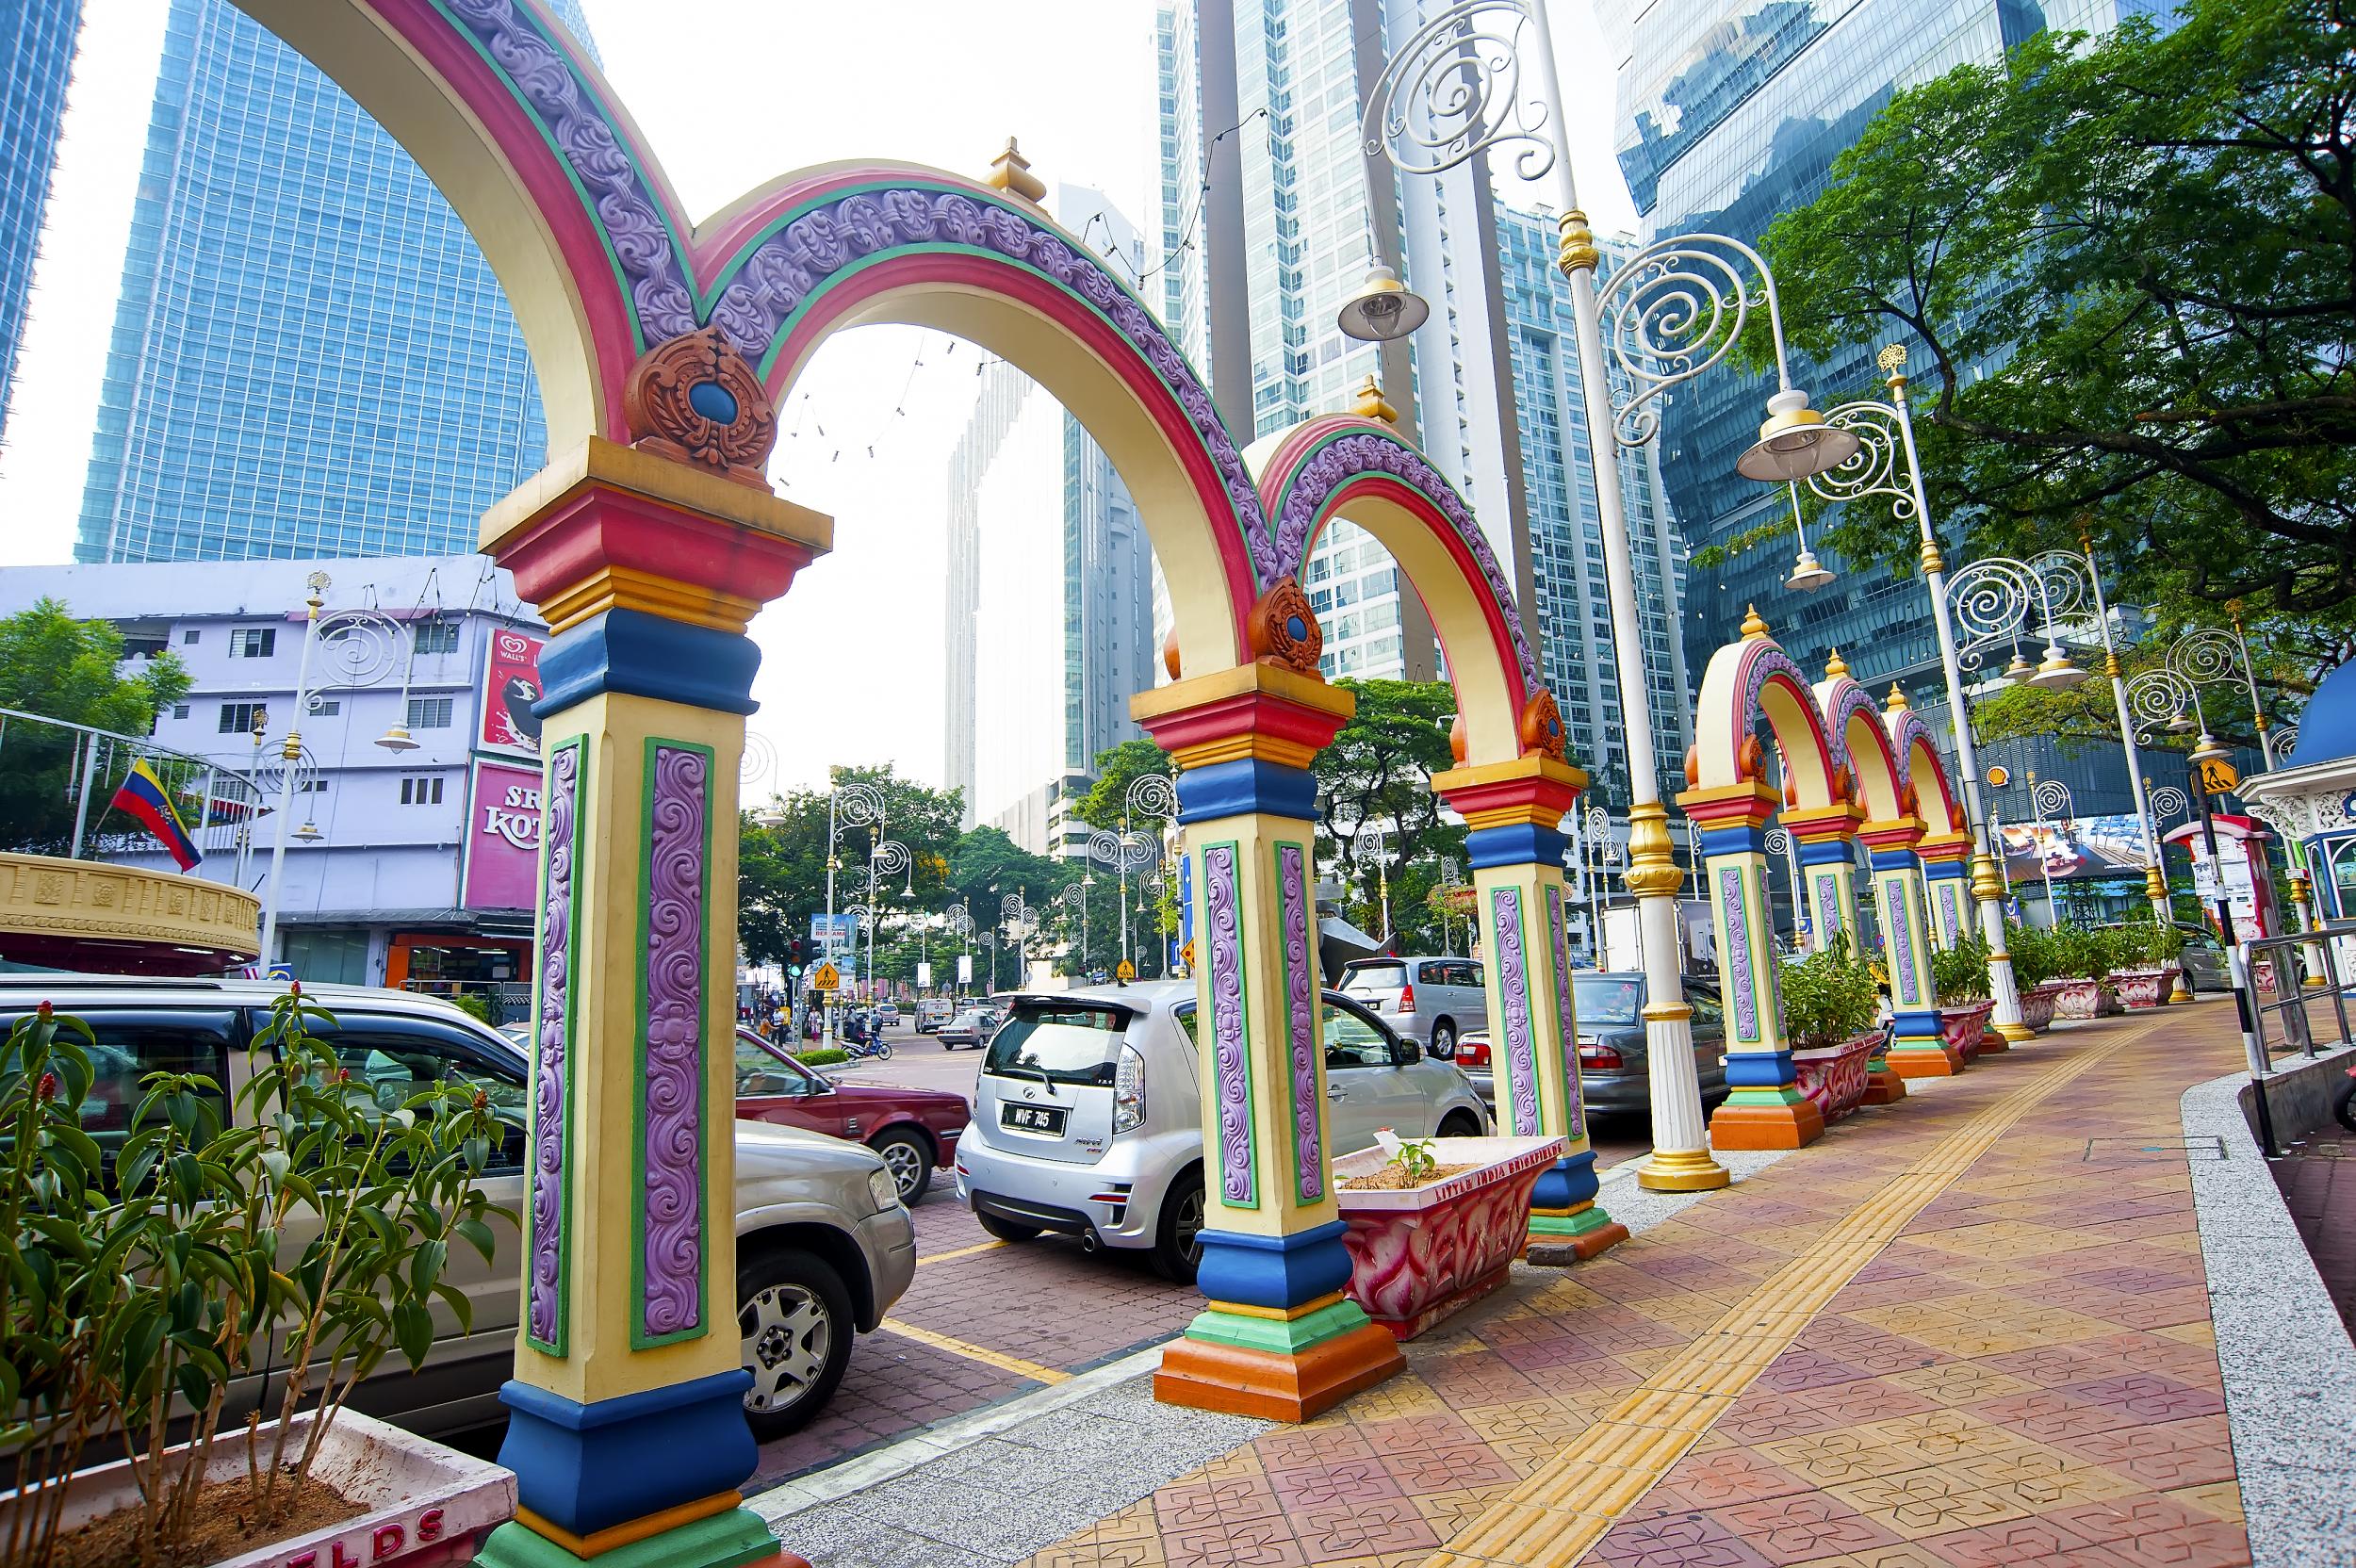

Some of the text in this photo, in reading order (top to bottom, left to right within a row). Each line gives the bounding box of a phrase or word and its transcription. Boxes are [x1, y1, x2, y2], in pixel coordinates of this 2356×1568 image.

[500, 650, 525, 662] WALL'S
[1015, 1108, 1050, 1128] WVF 745
[1434, 1143, 1562, 1202] LITTLE INDIA BRICKFIELDS
